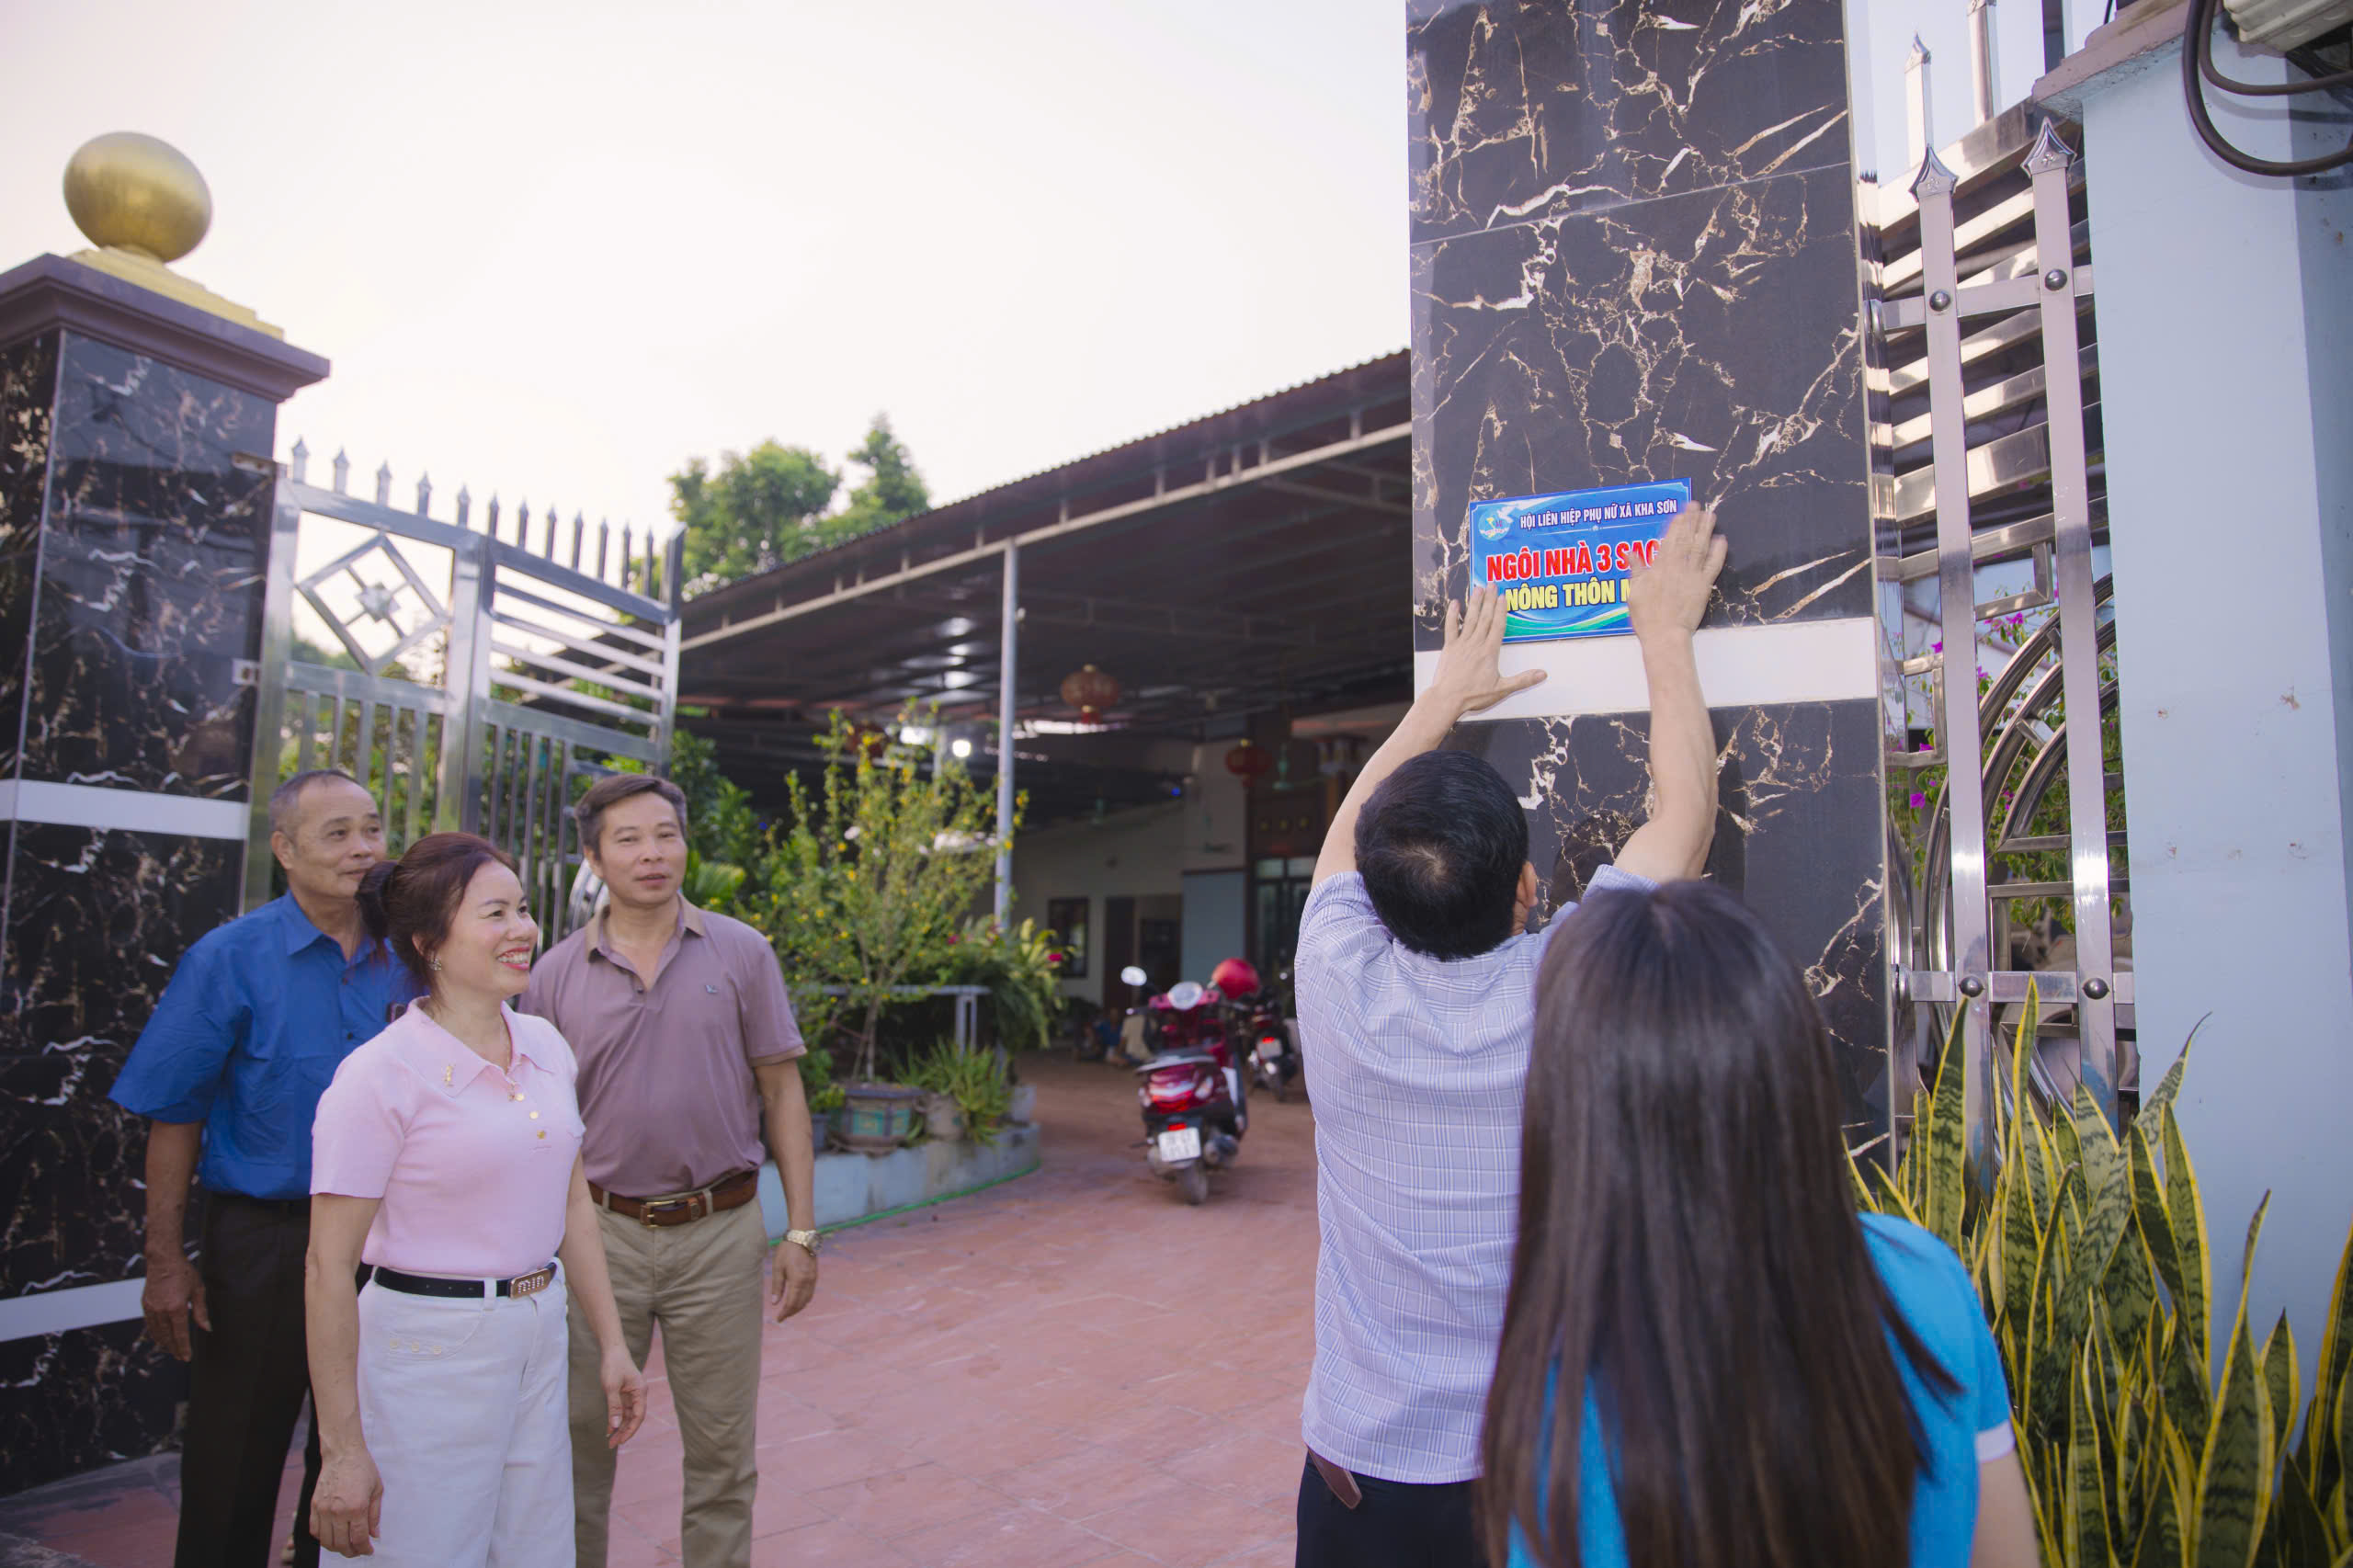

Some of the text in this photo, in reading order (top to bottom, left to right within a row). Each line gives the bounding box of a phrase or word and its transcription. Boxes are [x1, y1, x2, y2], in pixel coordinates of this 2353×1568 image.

[1520, 499, 1677, 530] HỘI LIÊN HIỆP PHỤ NỮ XÃ KHA SƠN
[1486, 546, 1540, 583] NGÔI
[1545, 540, 1594, 577] NHÀ
[1596, 543, 1612, 574] 3
[1505, 583, 1559, 611] NÔNG
[1562, 576, 1616, 607] THÔN
